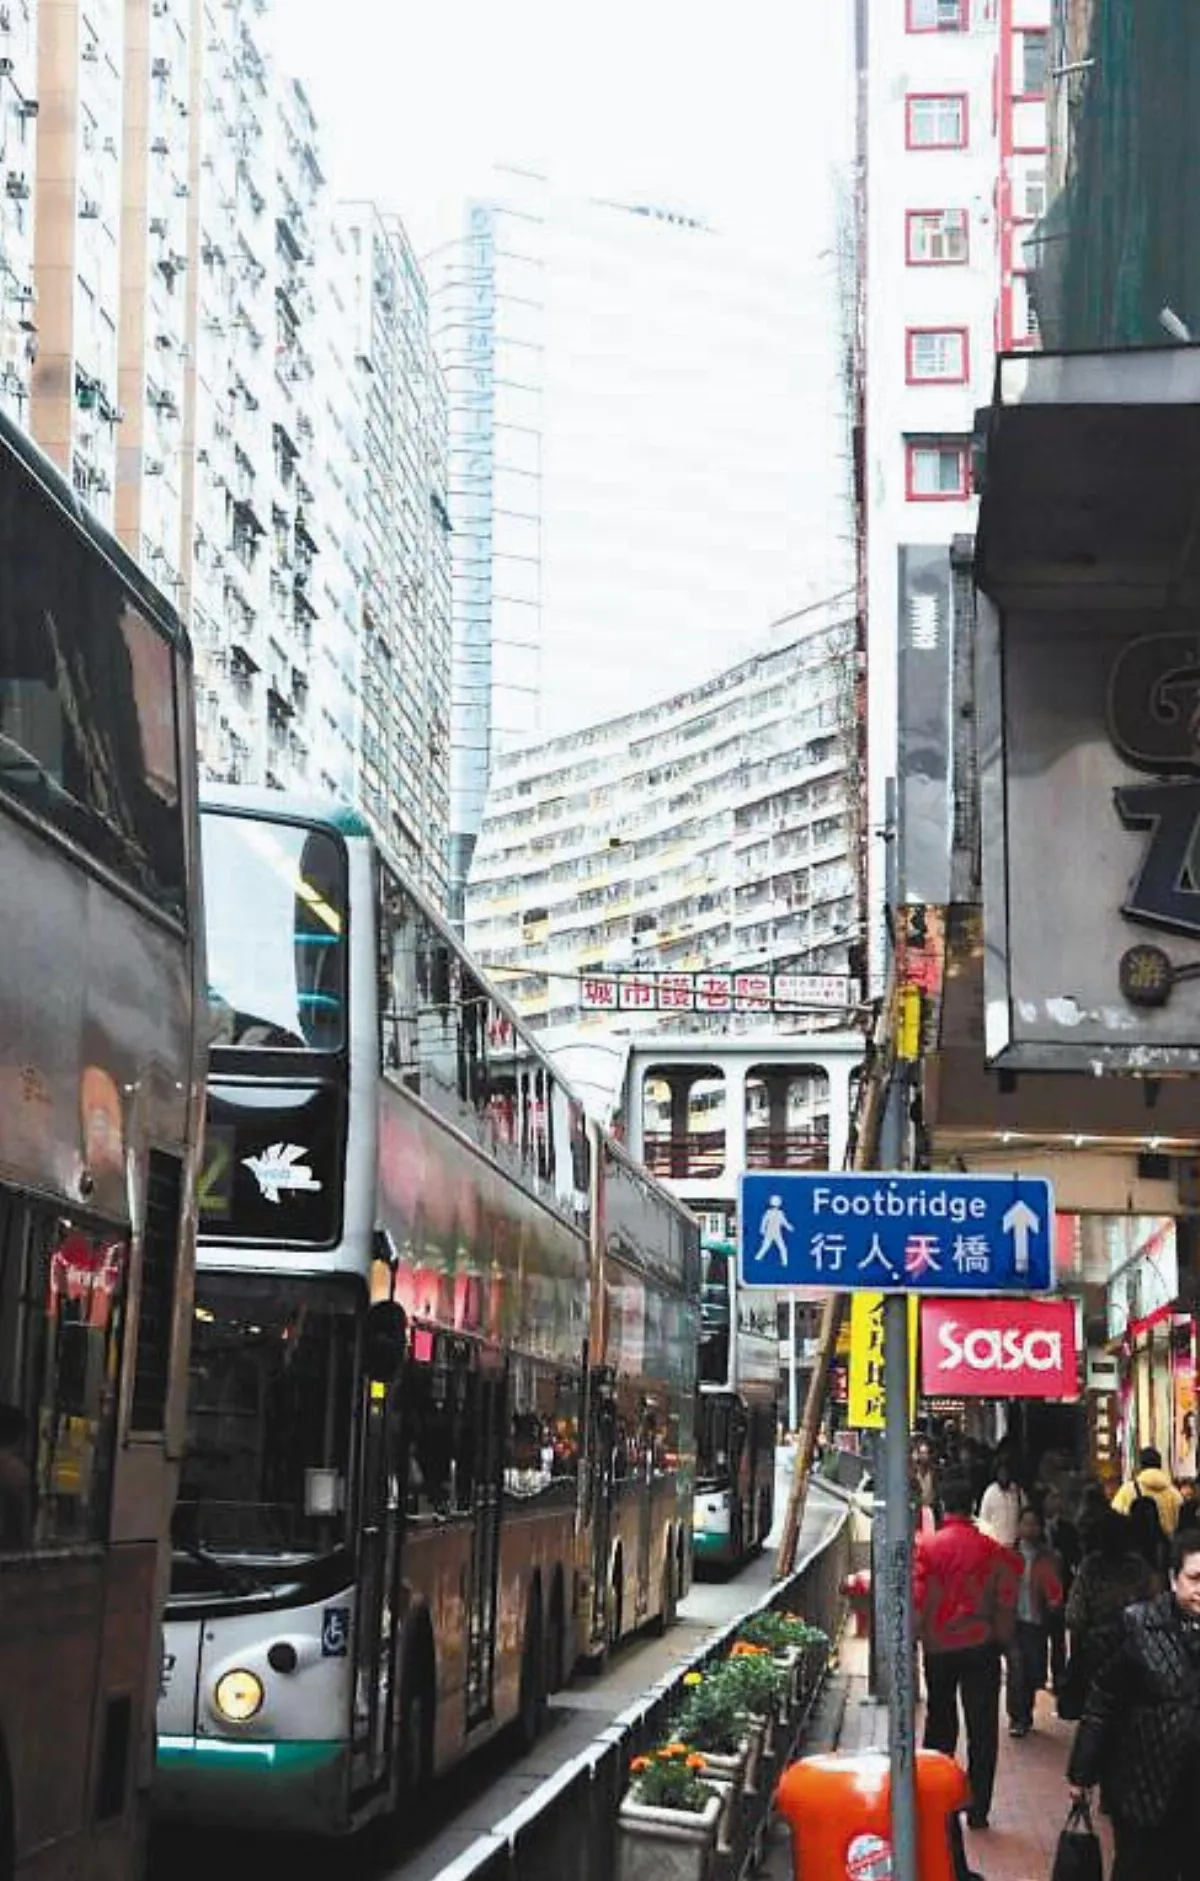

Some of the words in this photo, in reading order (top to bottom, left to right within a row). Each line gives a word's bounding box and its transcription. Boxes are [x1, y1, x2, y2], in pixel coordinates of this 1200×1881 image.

[1113, 785, 1200, 935] Z
[584, 976, 769, 1009] 城市護老院
[813, 1187, 987, 1223] Footbridge
[810, 1232, 991, 1275] 行人天橋
